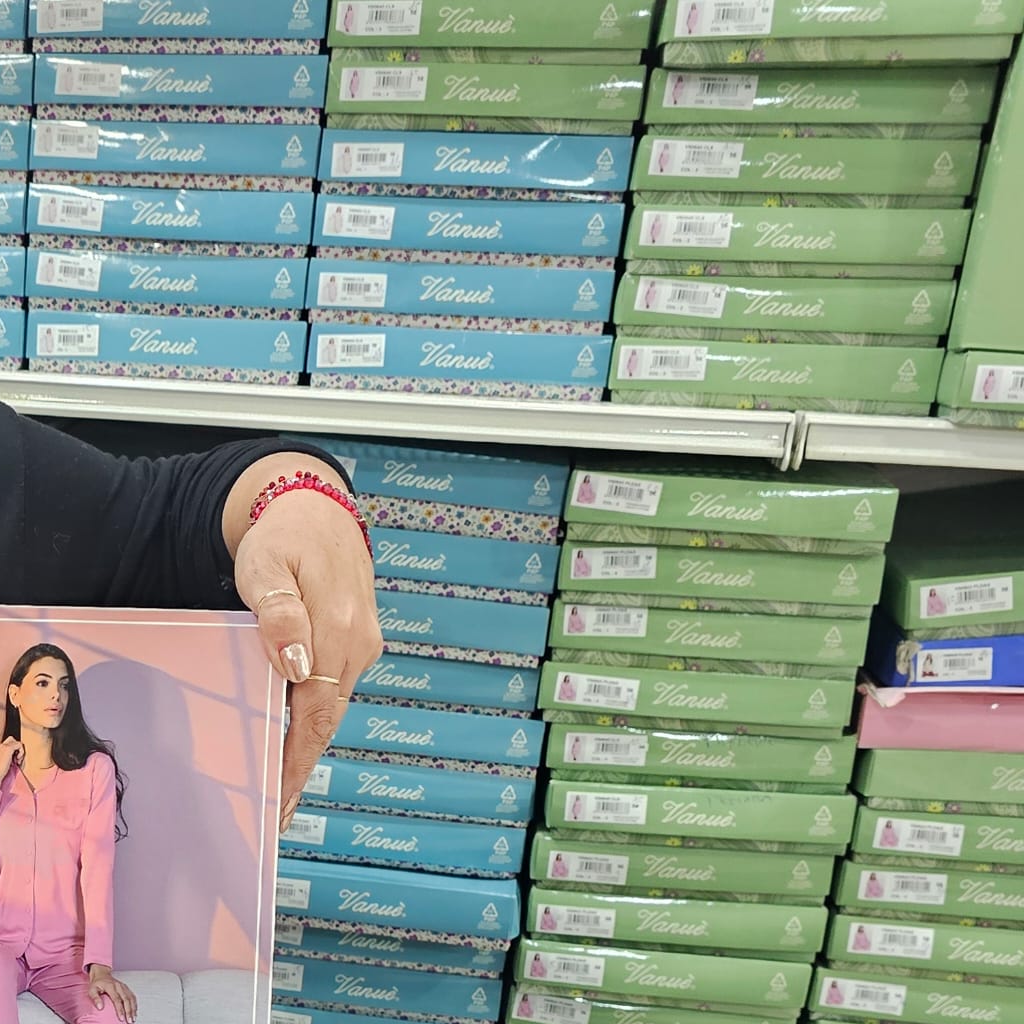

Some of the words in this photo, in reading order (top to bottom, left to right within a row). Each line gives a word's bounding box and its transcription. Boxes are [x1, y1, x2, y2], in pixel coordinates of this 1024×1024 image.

[136, 0, 211, 27] Vanuè
[438, 7, 516, 34] Vanuè
[139, 66, 213, 94] Vanuè
[444, 76, 520, 102] Vanuè
[777, 82, 860, 110] Vanuè
[136, 135, 206, 162] Vanuè
[435, 147, 510, 174] Vanuè
[763, 152, 845, 181] Vanuè
[132, 200, 203, 228] Vanuè
[426, 212, 503, 239] Vanuè
[754, 222, 837, 250] Vanuè
[129, 265, 198, 292] Vanuè
[419, 275, 495, 304] Vanuè
[743, 291, 825, 318] Vanuè
[129, 327, 198, 355] Vanuè
[419, 341, 494, 370] Vanuè
[732, 356, 813, 385] Vanuè
[382, 461, 453, 491] Vanuè
[687, 493, 768, 521] Vanuè
[376, 541, 446, 571] Vanuè
[677, 559, 757, 588] Vanuè
[665, 620, 741, 648] Vanuè
[653, 682, 729, 711] Vanuè
[366, 718, 434, 746] Vanuè
[661, 738, 736, 769] Vanuè
[357, 772, 424, 800] Vanuè
[662, 800, 736, 829] Vanuè
[352, 824, 419, 852] Vanuè
[644, 855, 716, 883] Vanuè
[338, 889, 406, 918] Vanuè
[958, 879, 1024, 907] Vanu
[636, 910, 709, 937] Vanuè
[335, 974, 398, 1001] Vanuè
[625, 962, 696, 990] Vanuè
[926, 993, 999, 1021] Vanuè
